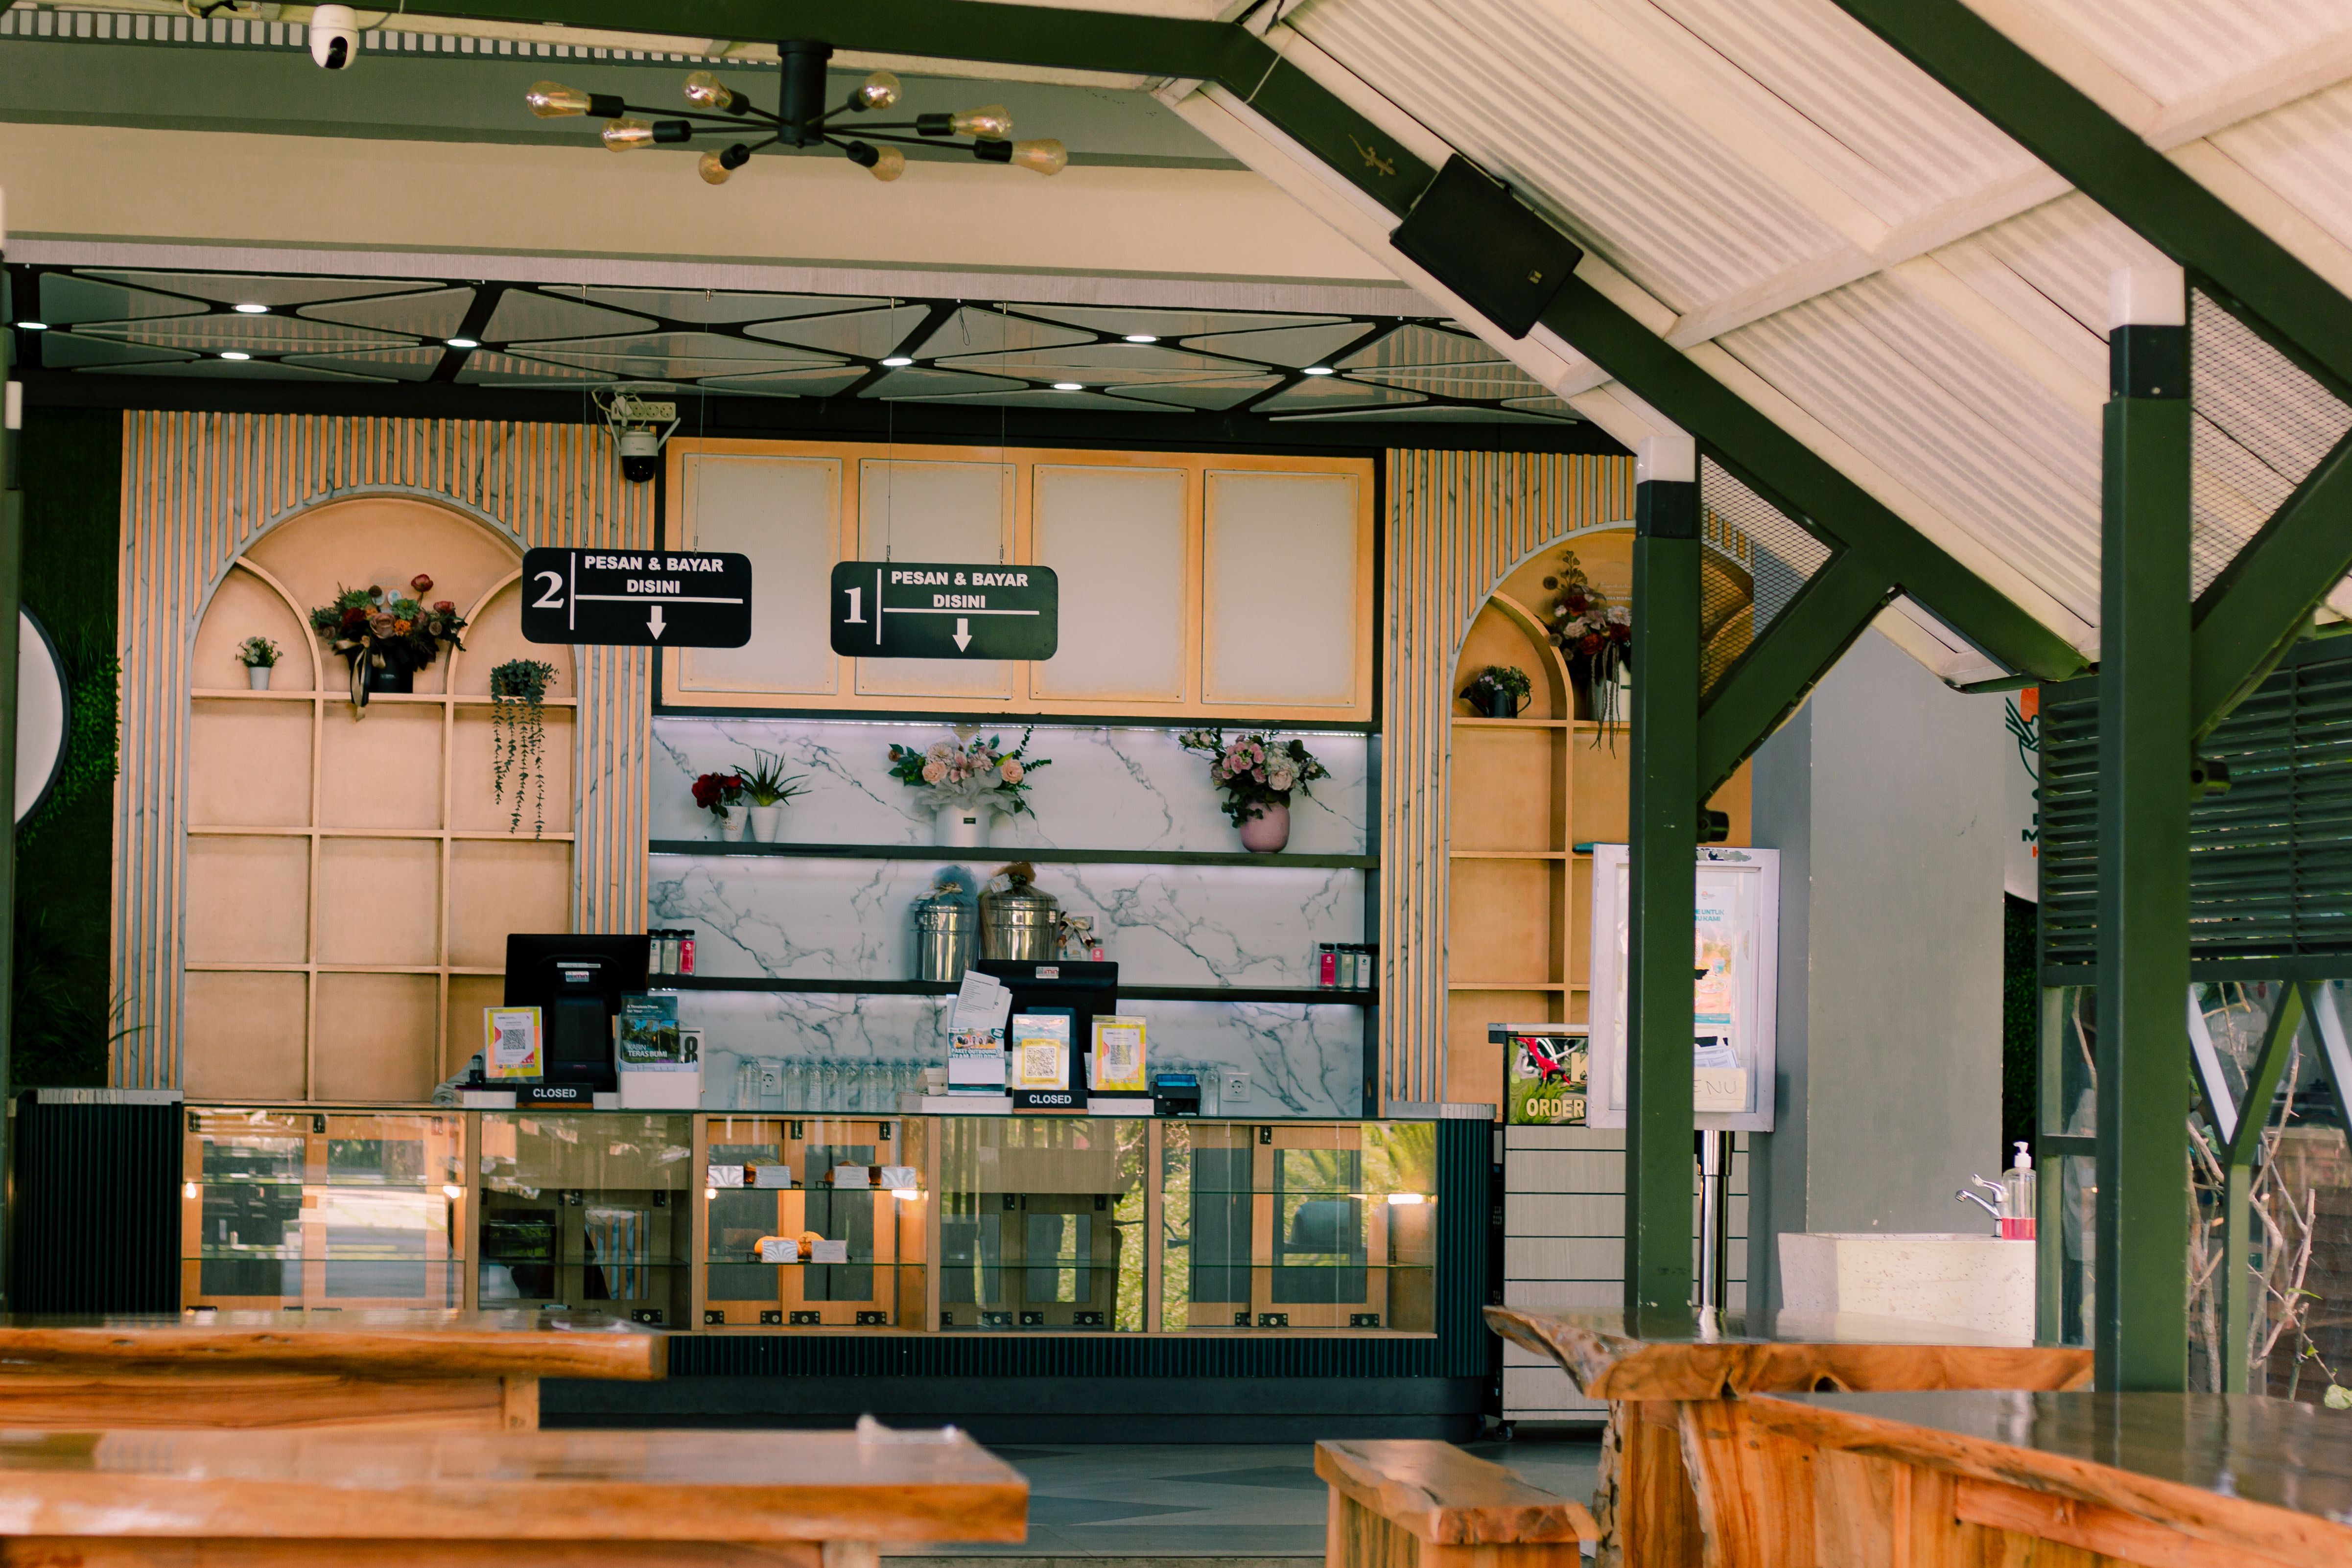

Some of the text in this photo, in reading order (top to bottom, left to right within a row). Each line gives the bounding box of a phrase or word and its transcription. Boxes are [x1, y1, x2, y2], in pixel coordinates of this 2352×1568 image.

[585, 556, 724, 572] PESAN & BAYAR
[626, 579, 681, 594] DISINI
[891, 571, 1029, 587] PESAN & BAYAR
[532, 571, 564, 608] 2
[844, 586, 868, 623] 1
[933, 594, 986, 608] DISINI
[533, 1088, 577, 1098] CLOSED
[1693, 1079, 1736, 1095] ENU
[1029, 1094, 1072, 1104] CLOSED
[1526, 1098, 1585, 1117] ORDER
